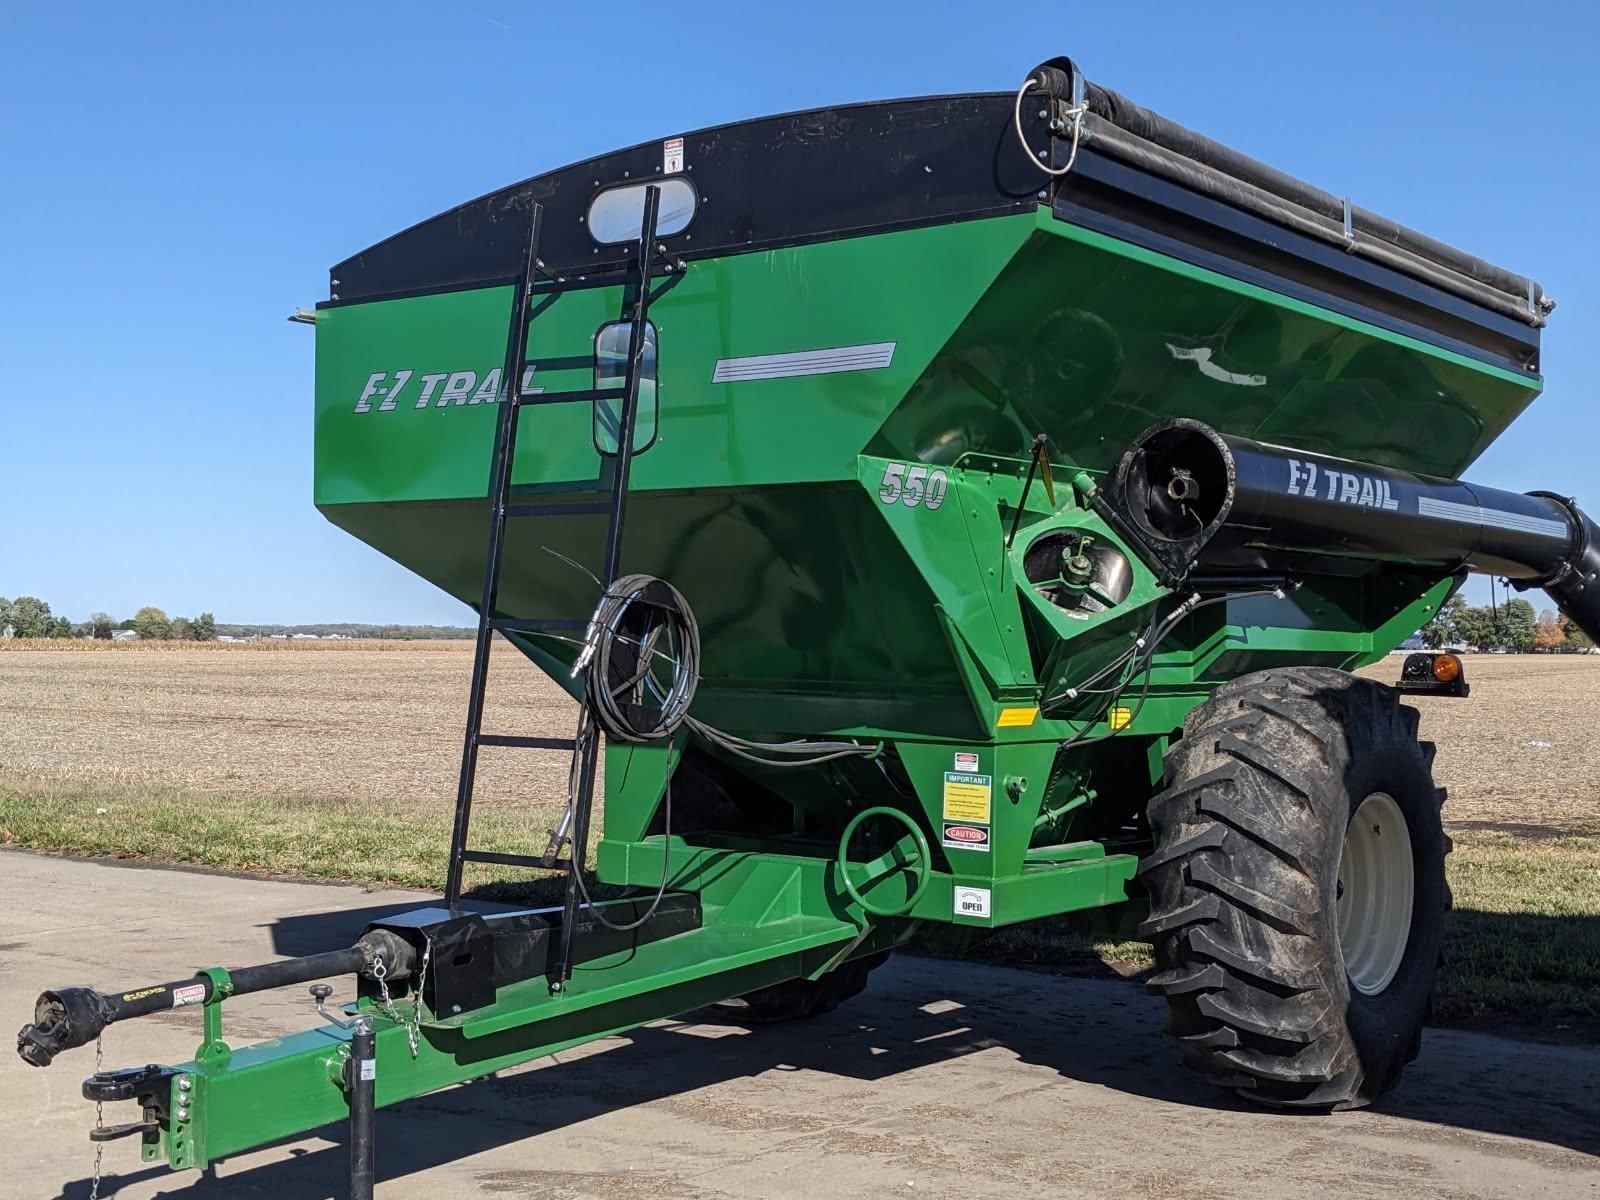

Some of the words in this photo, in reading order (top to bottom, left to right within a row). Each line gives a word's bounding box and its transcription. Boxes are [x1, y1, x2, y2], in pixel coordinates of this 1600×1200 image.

[879, 461, 948, 511] 550
[1287, 458, 1318, 498] E-Z
[1324, 469, 1399, 511] TRAIL
[949, 774, 987, 785] IMPORTANT
[950, 829, 983, 840] CAUTION
[962, 902, 983, 912] OPEN
